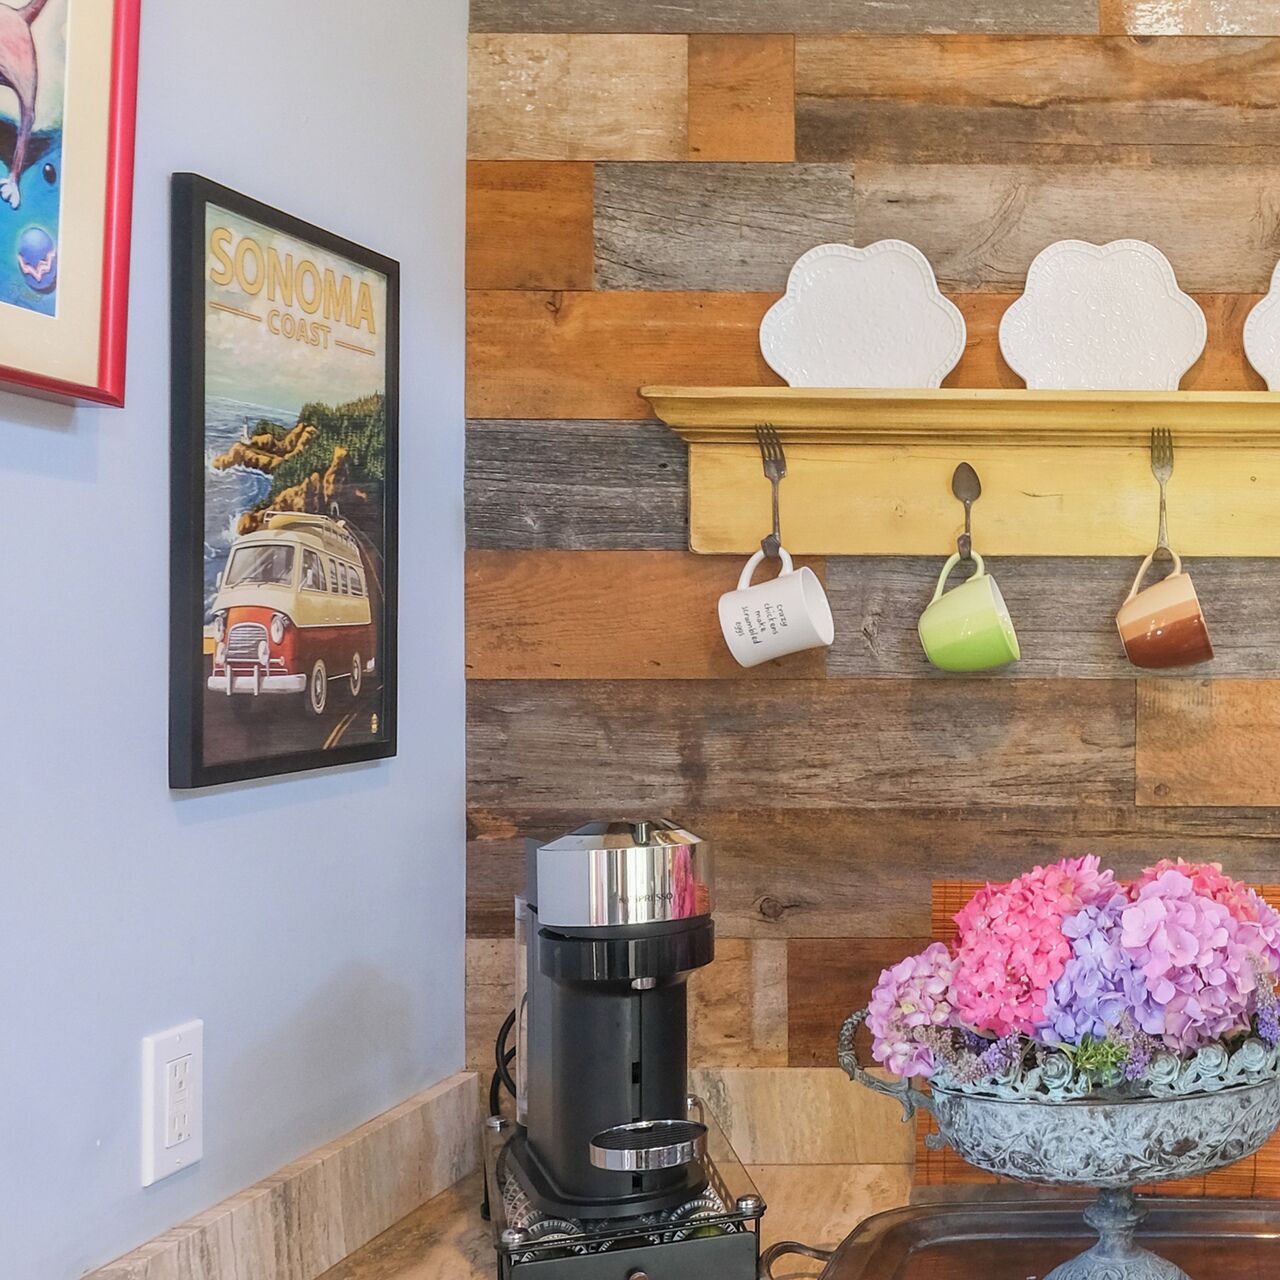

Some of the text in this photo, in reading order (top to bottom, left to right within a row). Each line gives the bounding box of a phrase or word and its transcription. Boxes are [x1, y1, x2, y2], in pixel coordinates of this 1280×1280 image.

[209, 226, 376, 334] SONOMA
[267, 309, 331, 349] COAST
[734, 621, 745, 637] eggs
[741, 606, 762, 645] scrambled
[755, 610, 766, 632] make
[764, 603, 778, 635] chickens
[777, 604, 788, 627] crazy
